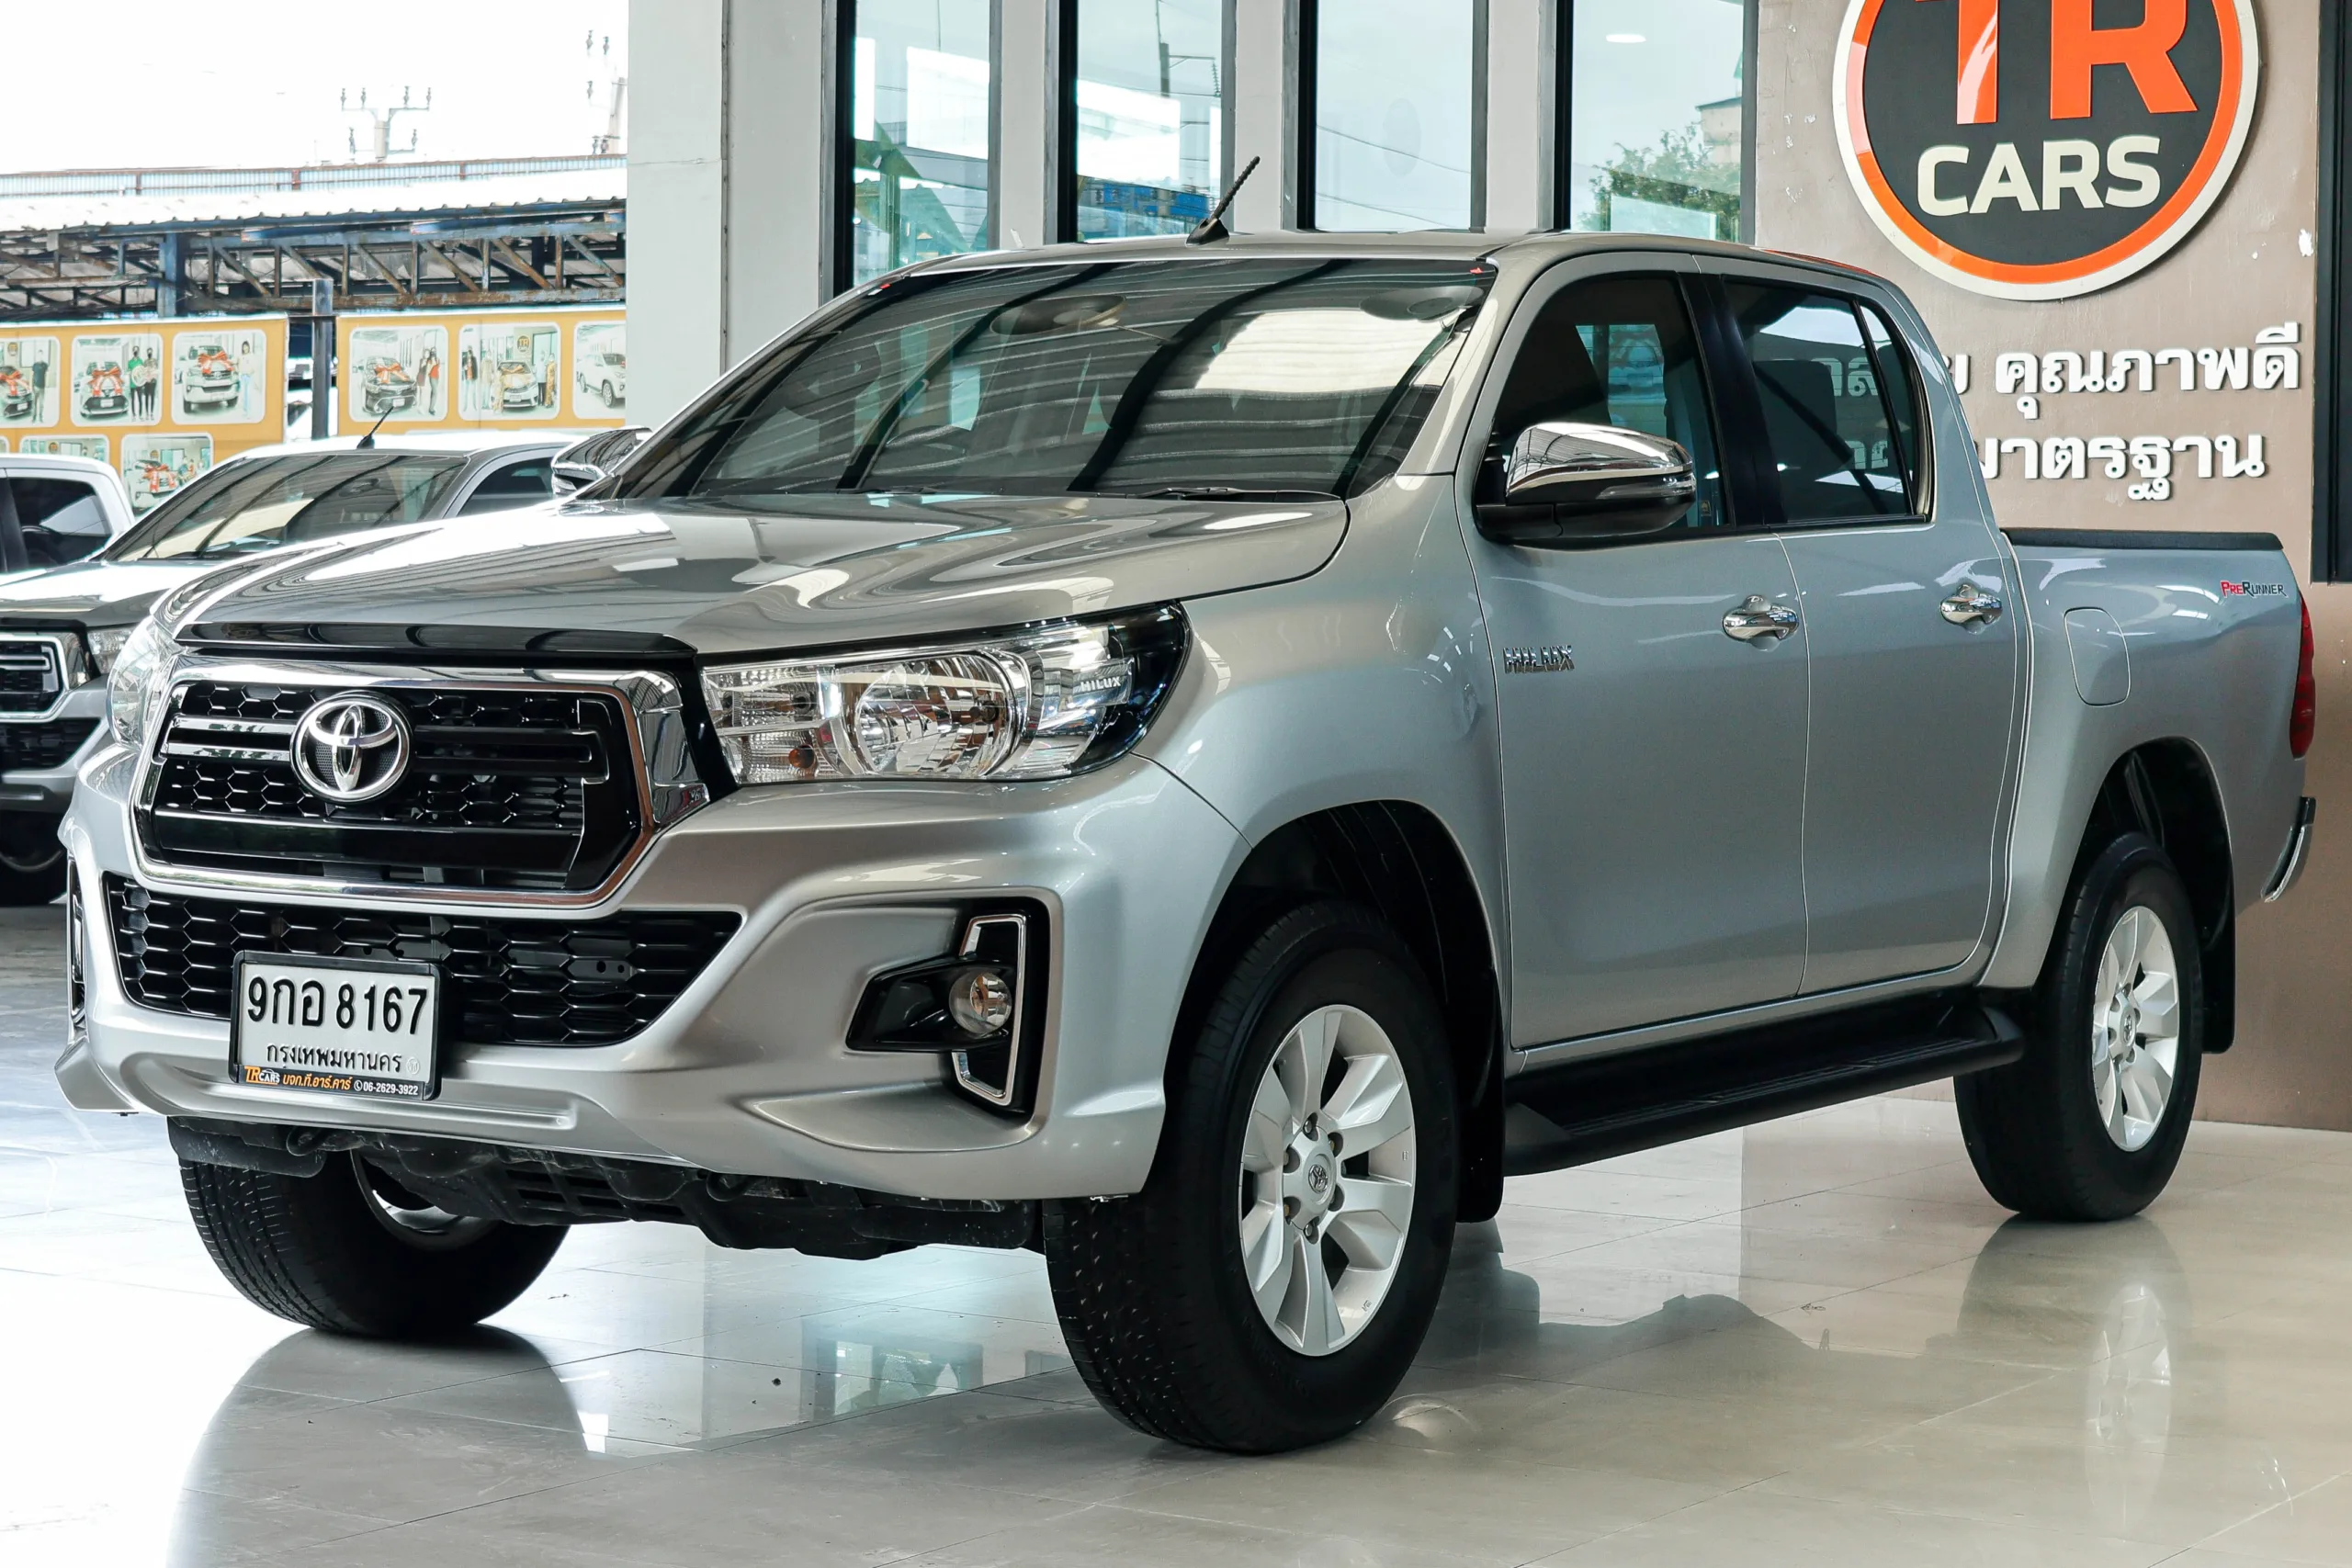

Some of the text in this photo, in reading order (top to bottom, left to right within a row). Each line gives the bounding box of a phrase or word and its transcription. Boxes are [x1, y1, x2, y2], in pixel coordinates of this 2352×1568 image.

[1917, 134, 2161, 216] CARS
[1996, 321, 2299, 420] คุณภาพดี
[1503, 645, 1575, 674] HILUX
[1080, 676, 1121, 692] HILUX
[248, 976, 427, 1035] 9กอ 8167
[363, 1080, 419, 1096] 06-2629-3922
